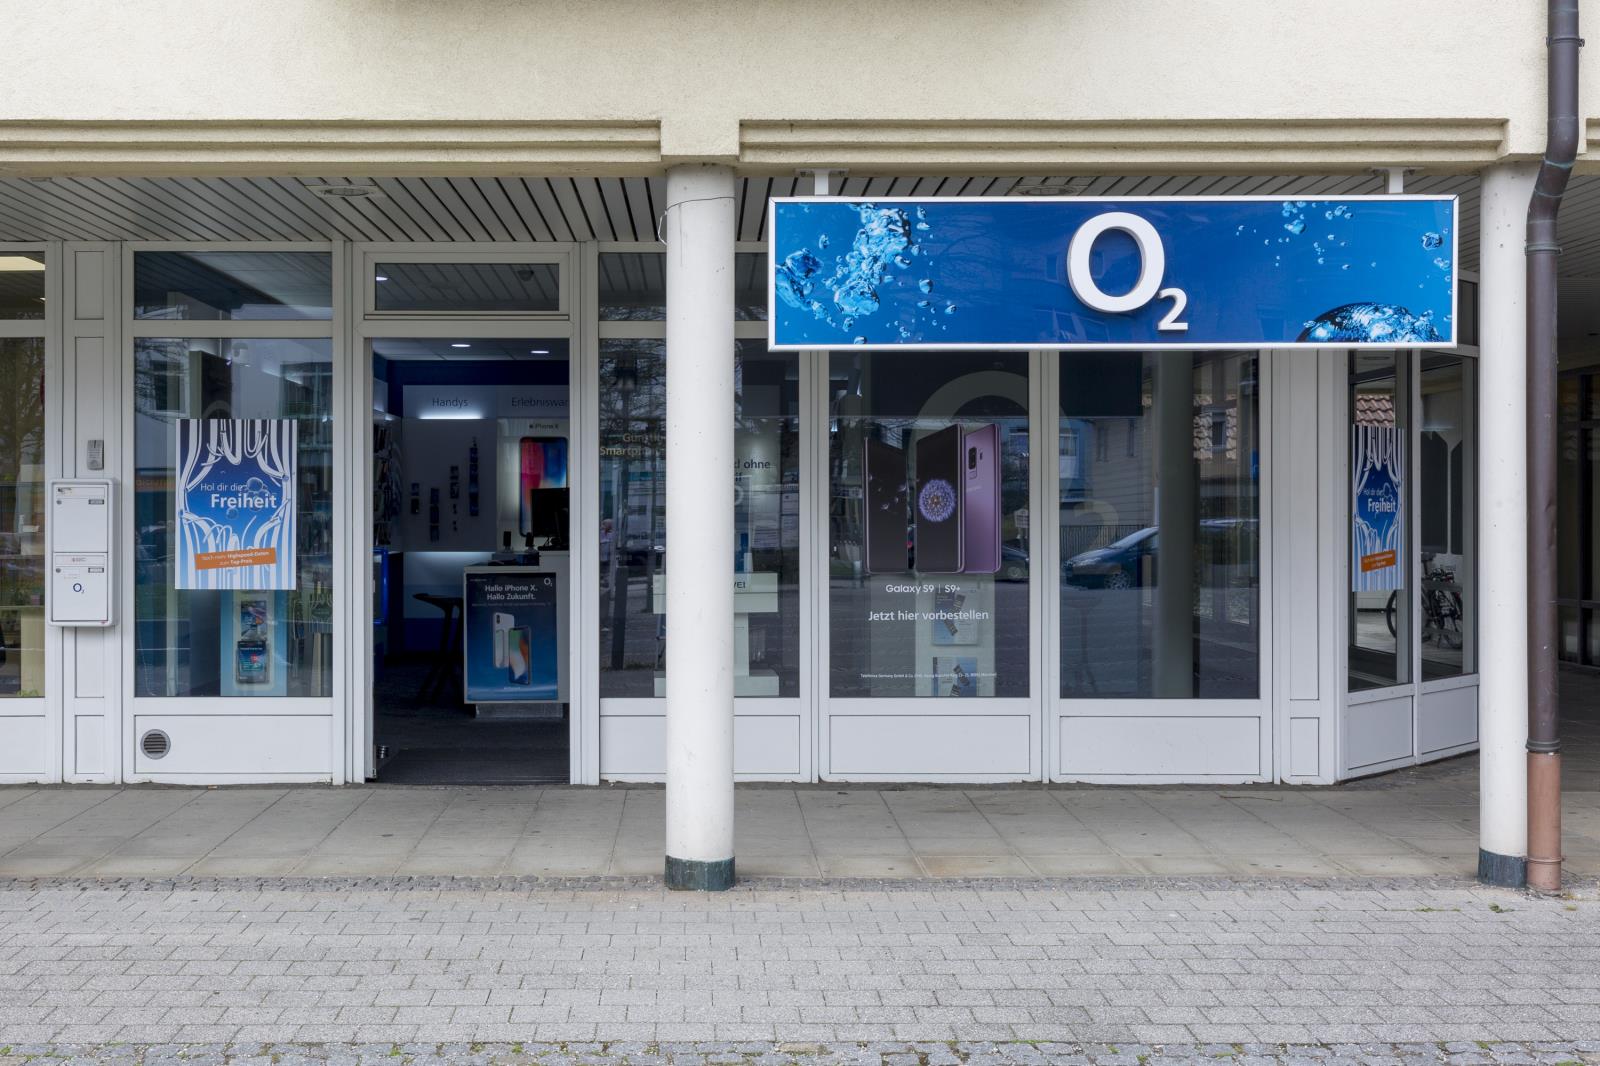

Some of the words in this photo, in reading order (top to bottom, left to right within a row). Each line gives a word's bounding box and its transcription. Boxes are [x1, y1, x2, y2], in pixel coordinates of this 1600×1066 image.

[1067, 211, 1189, 332] O2
[432, 397, 469, 409] Handys
[743, 459, 771, 469] ohne
[200, 483, 215, 492] Hol
[217, 483, 228, 492] dir
[230, 483, 243, 492] die
[211, 493, 277, 508] Freiheit
[1367, 498, 1397, 513] Freiheit
[485, 584, 503, 592] Hallo
[505, 584, 529, 592] iPhone
[530, 584, 538, 592] X.
[885, 584, 921, 595] Galaxy
[922, 584, 935, 593] S9
[487, 593, 505, 601] Hallo
[506, 593, 536, 601] Zukunft.
[868, 611, 895, 621] Jetzt
[898, 611, 919, 621] hier
[922, 610, 989, 621] vorbestellen
